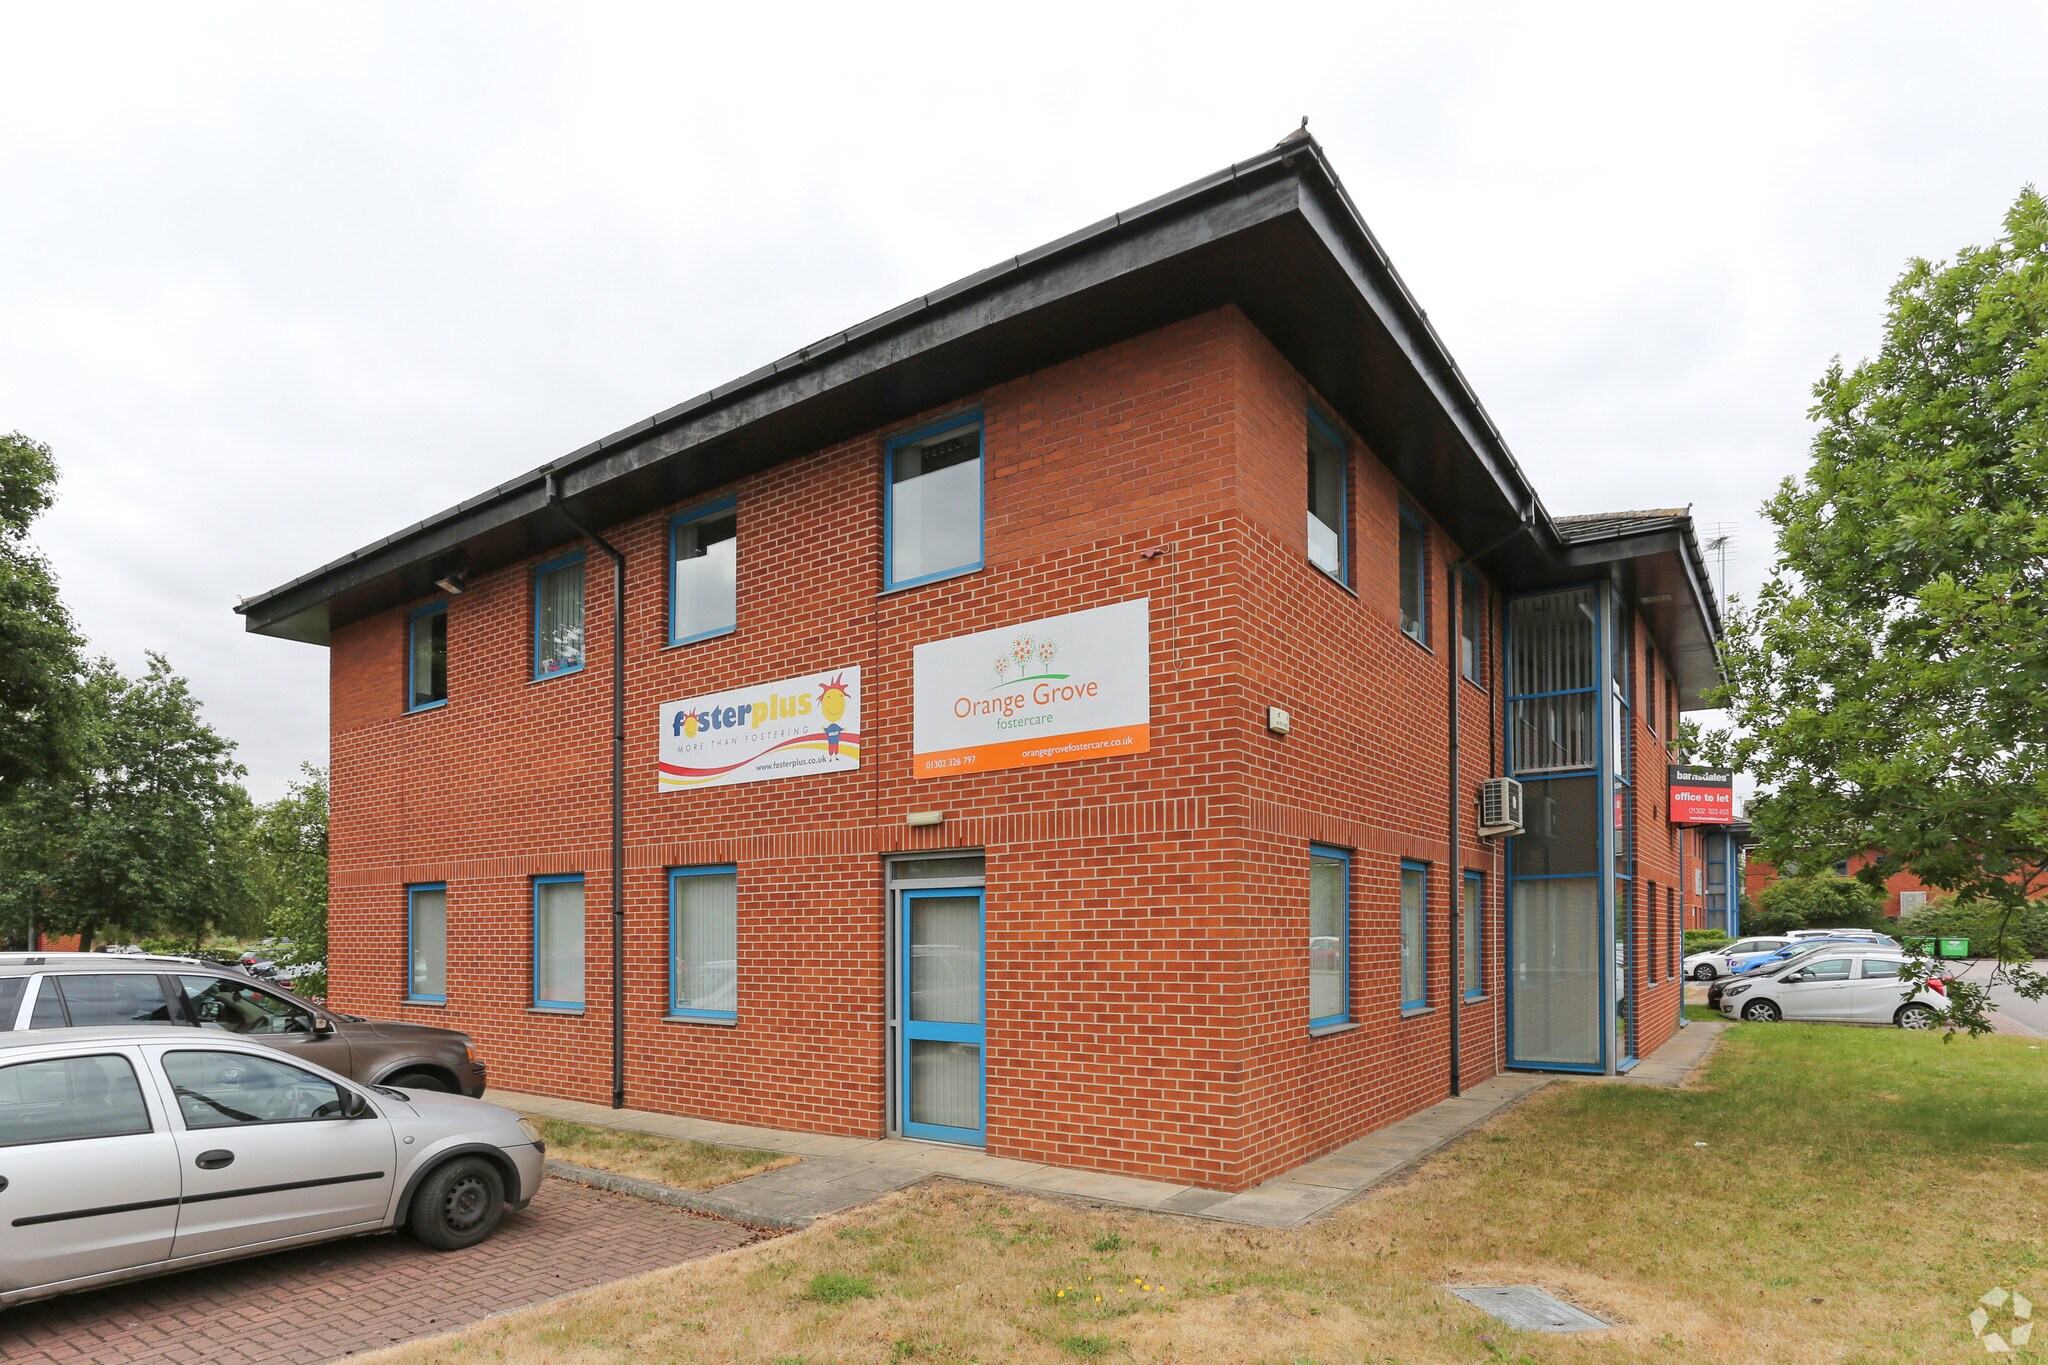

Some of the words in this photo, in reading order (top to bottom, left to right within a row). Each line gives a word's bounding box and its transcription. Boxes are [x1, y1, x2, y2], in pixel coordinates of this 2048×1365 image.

[954, 692, 1025, 718] Orange
[1033, 681, 1098, 706] Grove
[997, 714, 1054, 730] fostercare
[677, 742, 704, 753] MORE
[711, 738, 738, 749] THAN
[745, 725, 809, 742] FOSTERING
[1022, 735, 1133, 758] orangegrovefostercare.co.uk
[755, 754, 827, 772] www.fosterplus.co.uk
[925, 758, 947, 770] 01302
[948, 757, 961, 767] 326
[963, 755, 976, 766] 797
[1675, 792, 1701, 802] office
[1704, 793, 1714, 802] to
[1717, 794, 1729, 802] let
